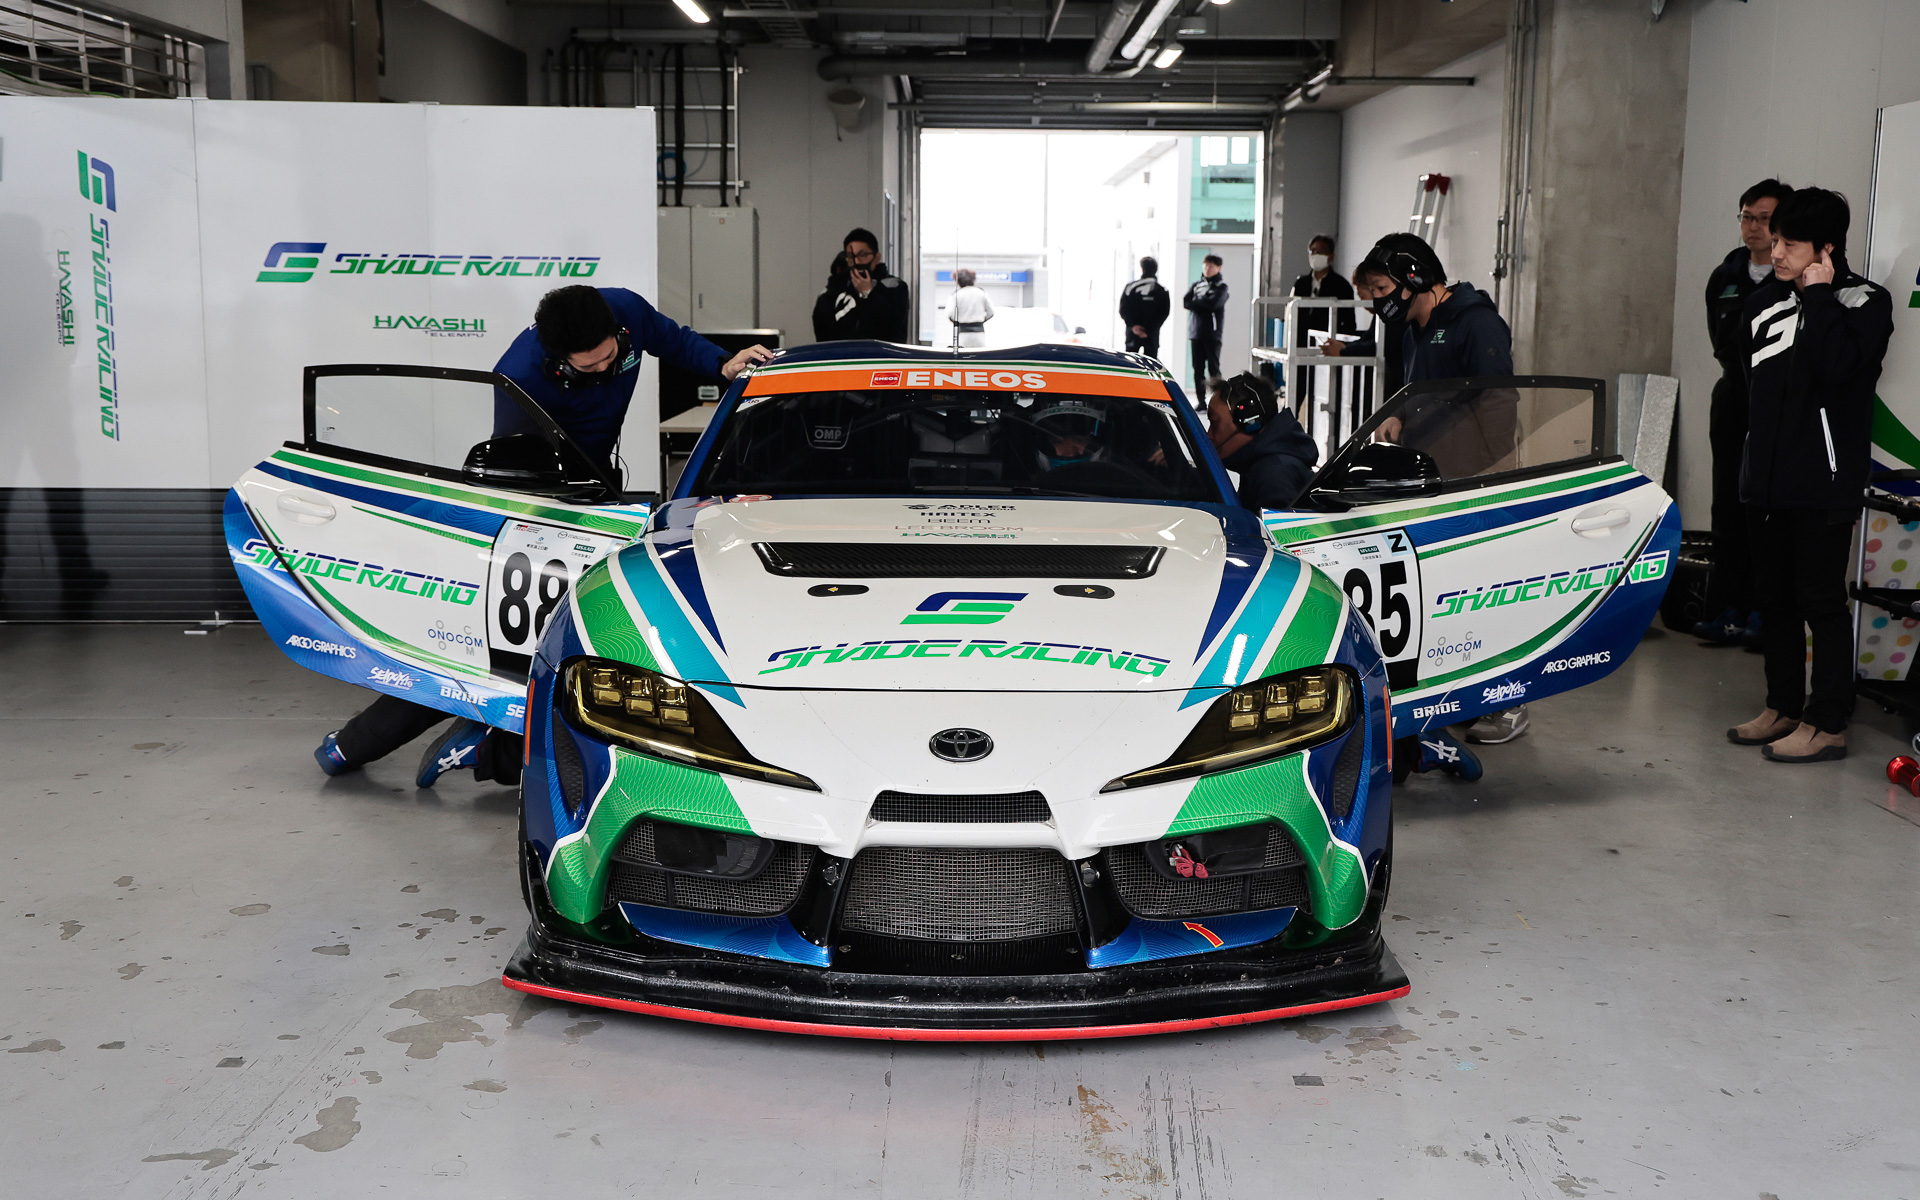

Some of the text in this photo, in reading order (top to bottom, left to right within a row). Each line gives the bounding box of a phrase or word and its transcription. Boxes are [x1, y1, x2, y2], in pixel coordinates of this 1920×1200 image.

[329, 253, 601, 277] SHADE RACING
[59, 251, 75, 344] HAYASHI
[90, 213, 120, 442] SHADE RACING
[374, 315, 485, 330] HAYASHI
[906, 371, 1047, 389] ENEOS
[814, 428, 842, 440] OMP
[1387, 533, 1408, 553] Z
[235, 540, 481, 606] SHADE RACING
[1431, 552, 1668, 619] SHADE RACING
[427, 628, 484, 648] ONOCOM
[312, 639, 357, 659] GRAPHICS
[757, 640, 1172, 677] SHADE RACING
[1427, 640, 1482, 658] ONOCOM
[1567, 651, 1611, 669] GRAPHICS
[439, 685, 489, 707] BRIDE
[1412, 700, 1461, 719] BRIDE
